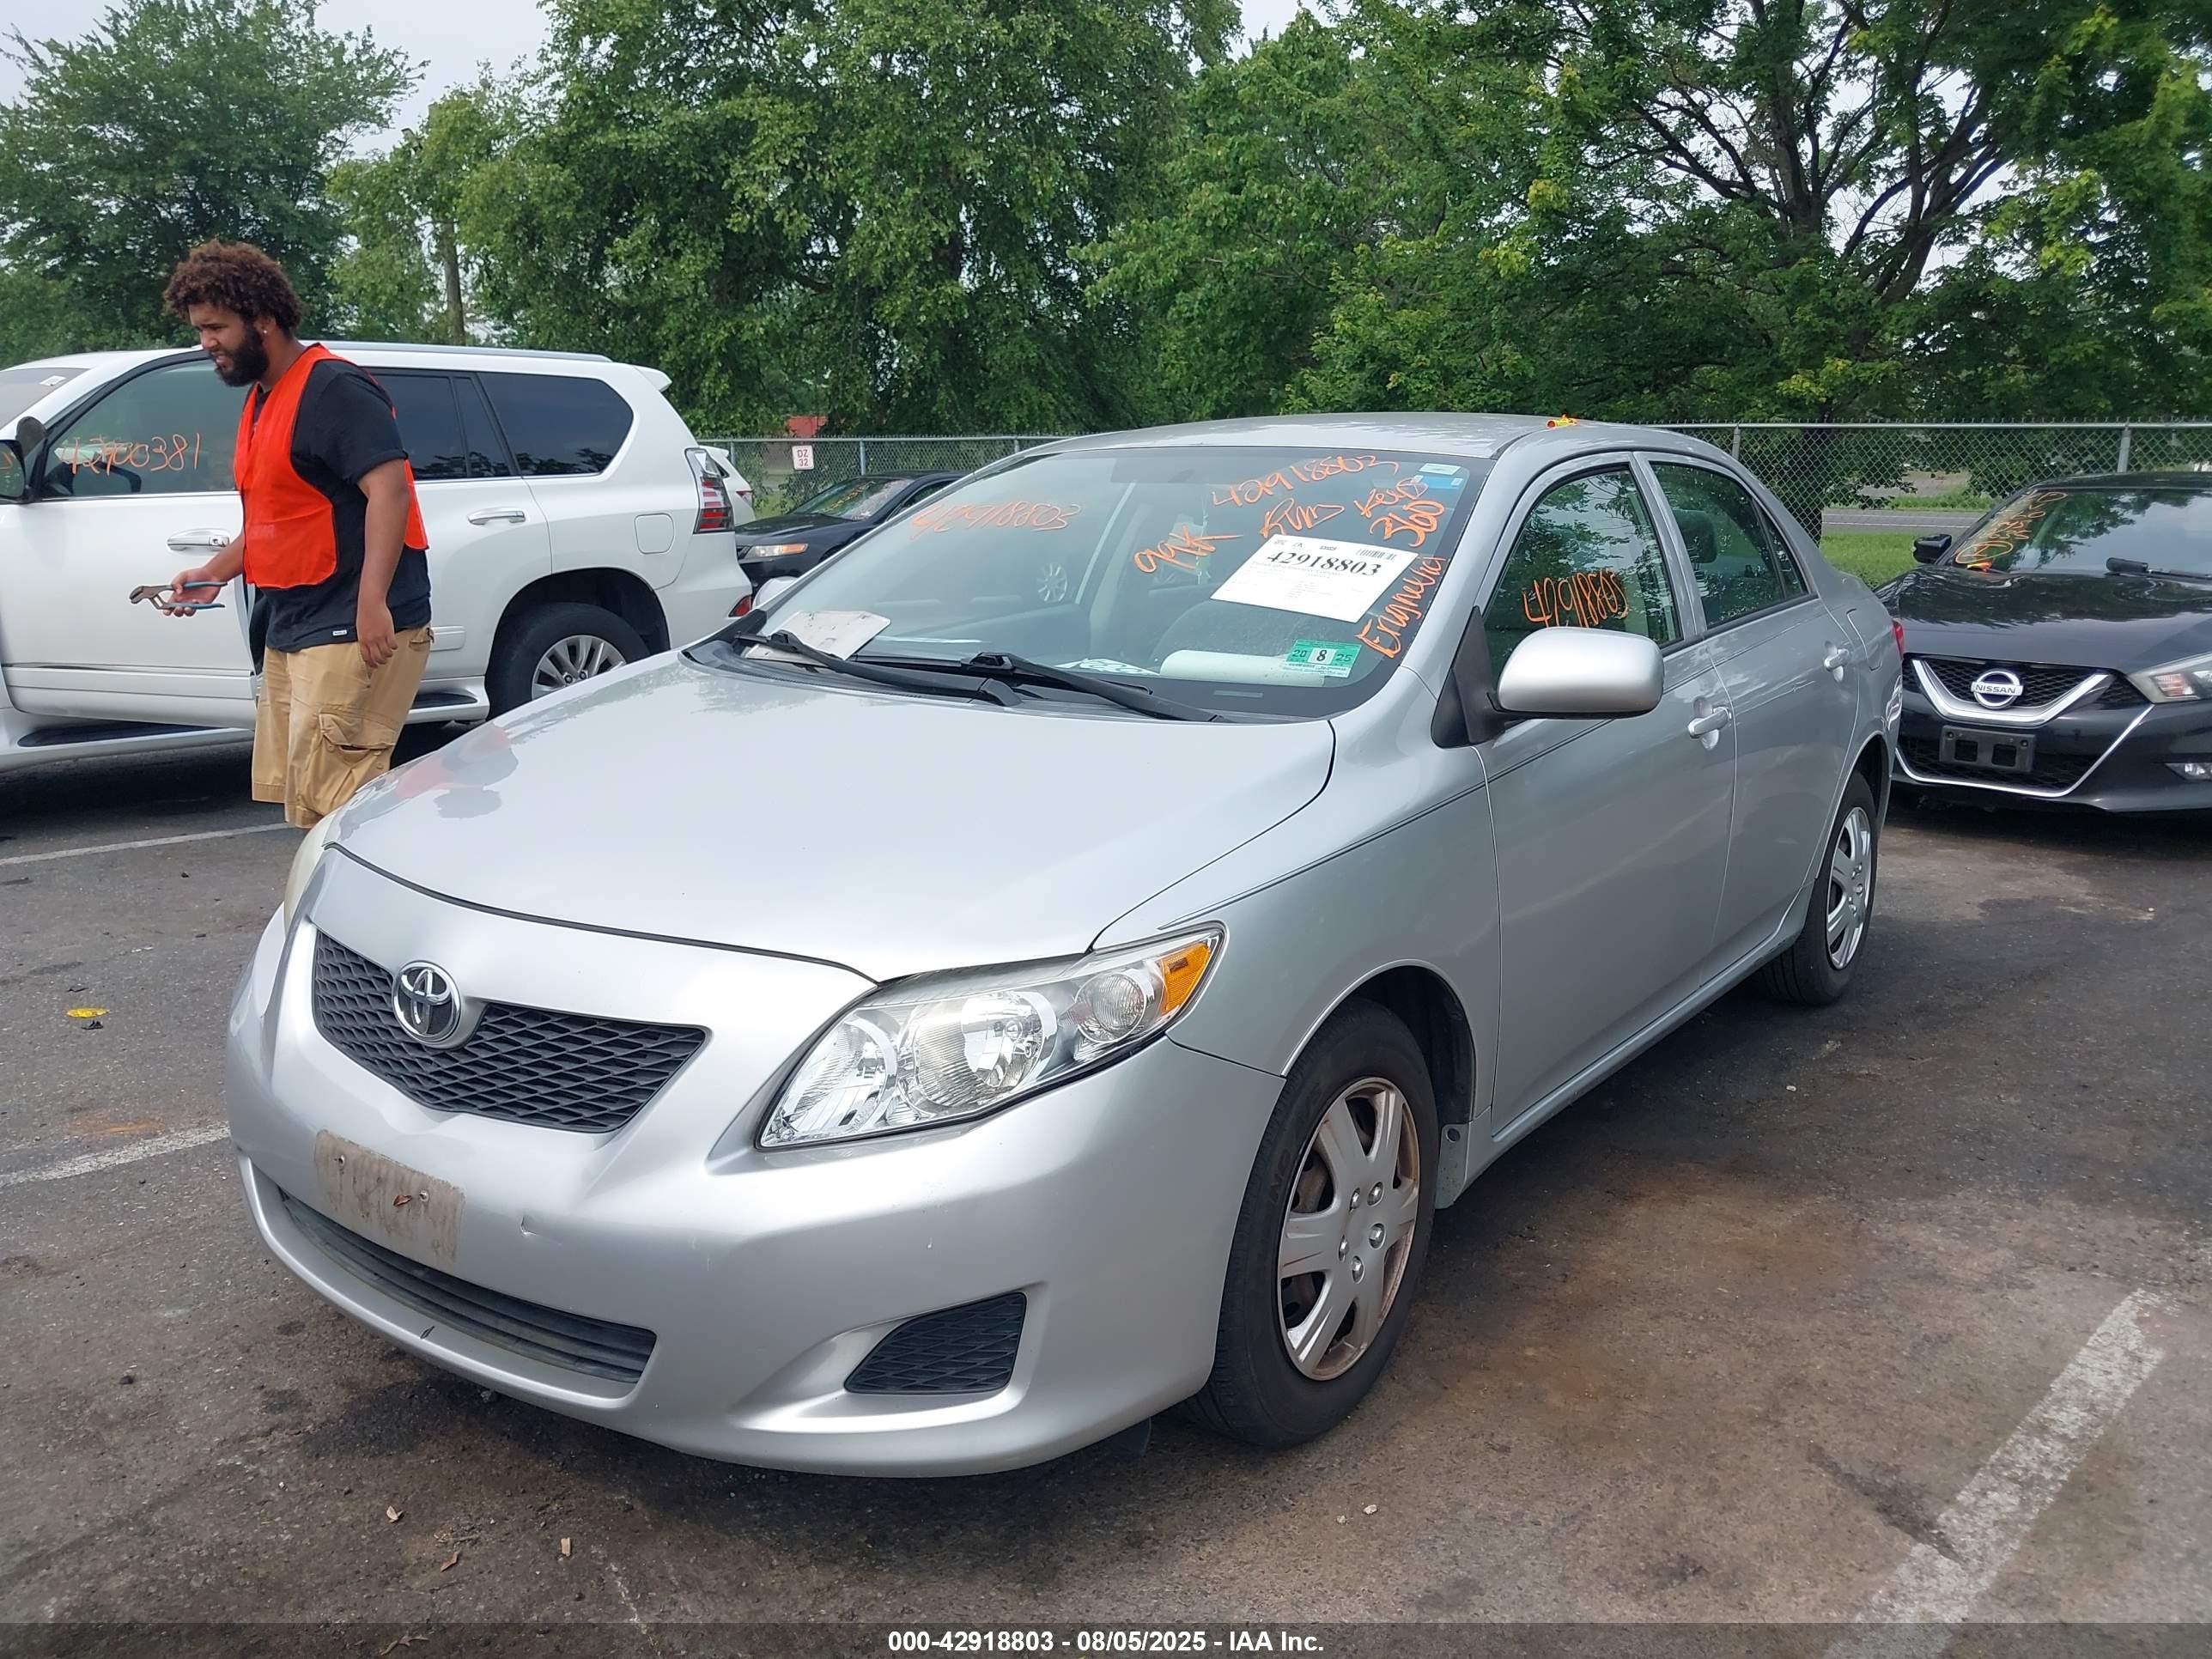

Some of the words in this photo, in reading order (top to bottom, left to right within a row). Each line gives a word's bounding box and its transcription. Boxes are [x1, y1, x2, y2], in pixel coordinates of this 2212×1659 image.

[1267, 550, 1382, 576] 42918803
[1316, 649, 1328, 662] 8
[1335, 653, 1352, 662] 25
[1975, 684, 2016, 694] NISSAN
